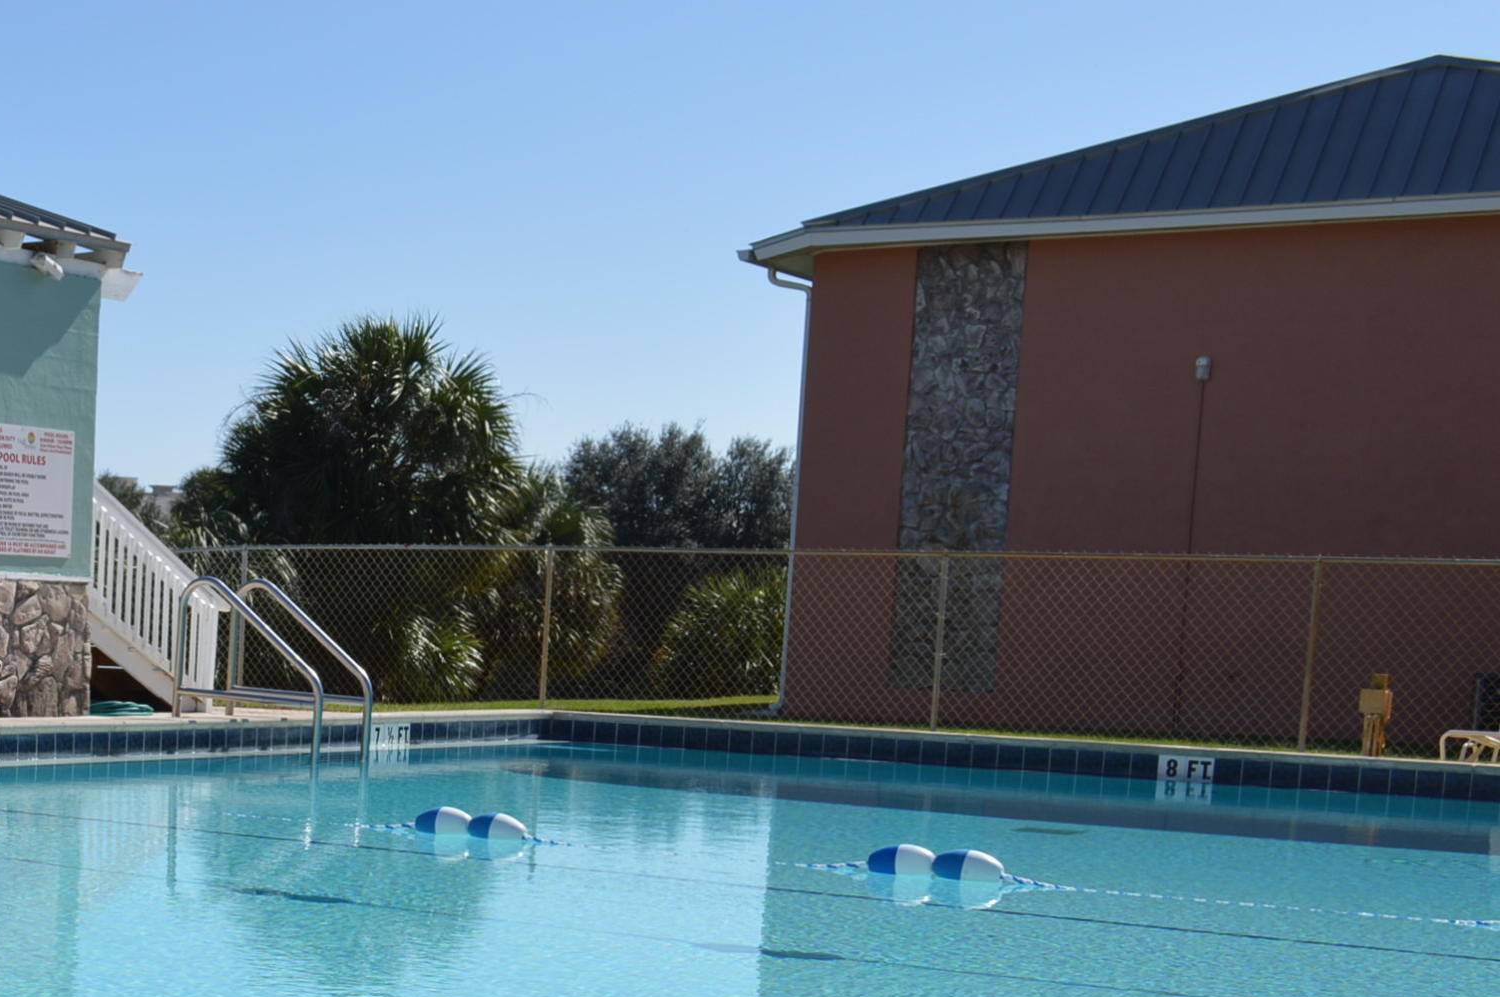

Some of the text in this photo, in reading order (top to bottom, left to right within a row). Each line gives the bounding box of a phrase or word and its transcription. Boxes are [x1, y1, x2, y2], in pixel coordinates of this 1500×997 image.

[21, 454, 47, 466] RULES
[375, 726, 381, 745] 7
[1166, 758, 1178, 778] 8
